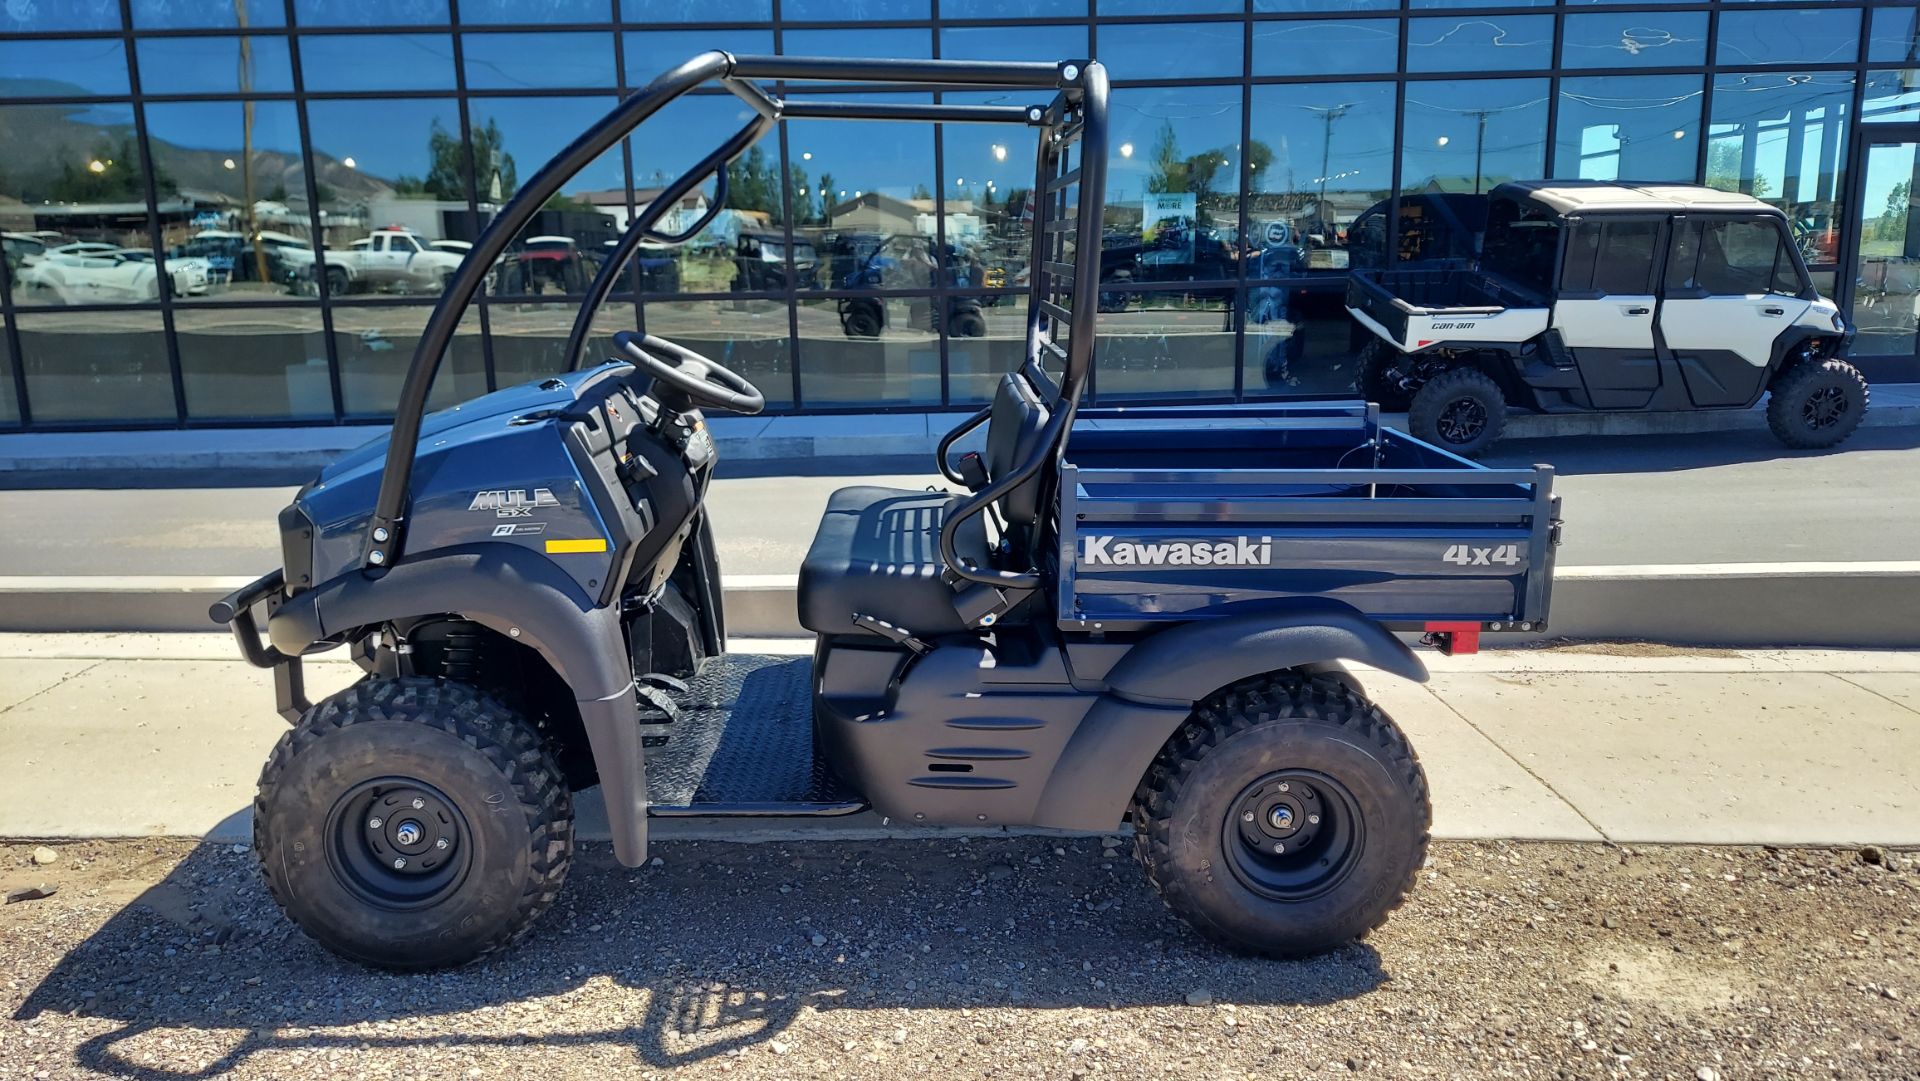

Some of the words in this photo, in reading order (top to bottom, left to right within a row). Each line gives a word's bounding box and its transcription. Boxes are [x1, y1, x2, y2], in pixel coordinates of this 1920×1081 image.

[468, 488, 561, 511] MULE
[1084, 535, 1272, 566] Kawasaki
[1442, 544, 1520, 566] 4x4
